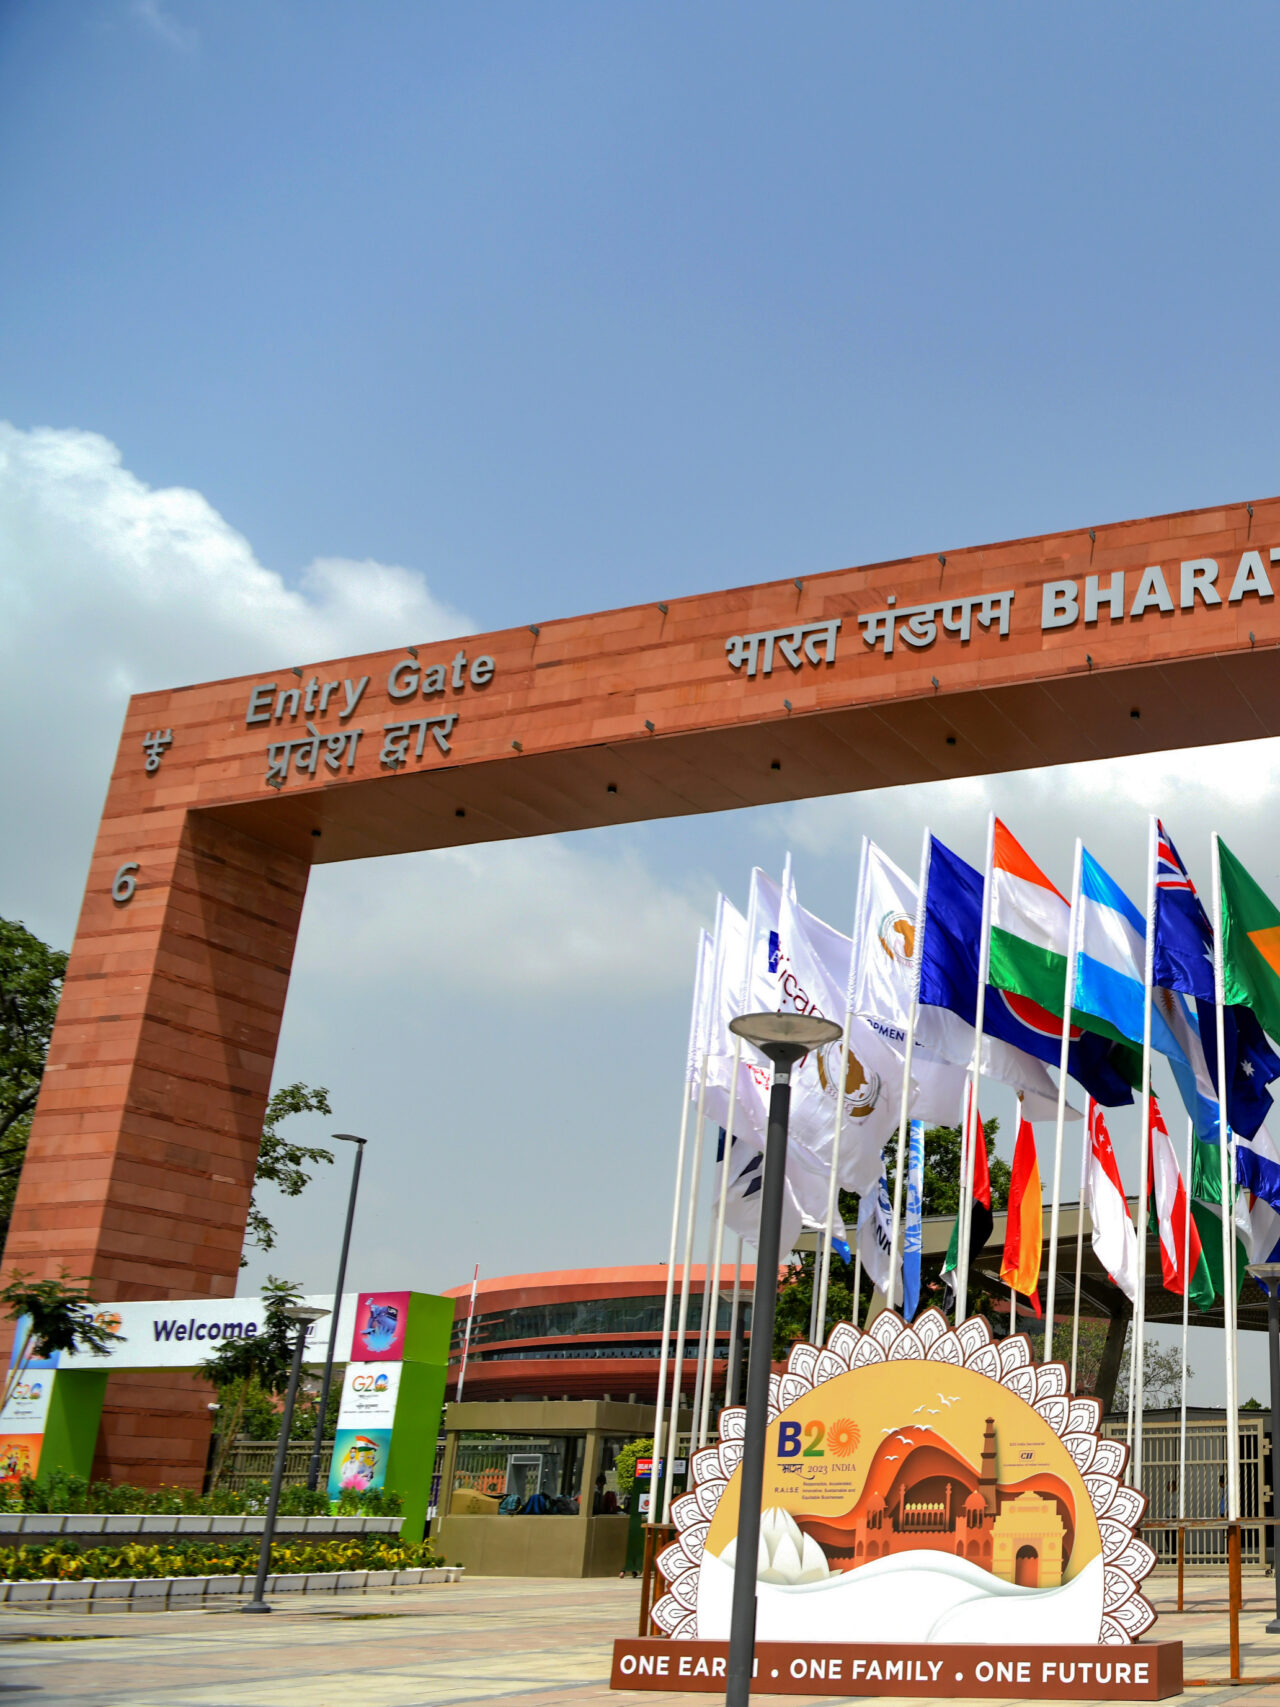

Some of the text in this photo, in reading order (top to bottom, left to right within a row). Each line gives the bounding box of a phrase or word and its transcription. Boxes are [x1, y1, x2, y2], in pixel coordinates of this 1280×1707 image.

[725, 589, 1016, 676] भारत मंडपम
[246, 650, 496, 724] Entry Gate
[265, 713, 460, 780] प्रवेश द्वार
[112, 861, 140, 902] 6
[153, 1318, 258, 1342] Welcome
[352, 1373, 389, 1392] G20
[777, 1416, 862, 1459] B20
[807, 1464, 829, 1475] 2023
[831, 1463, 857, 1472] INDIA
[619, 1654, 1150, 1685] ONE EAR ONE FAMILY ONE FUTURE
